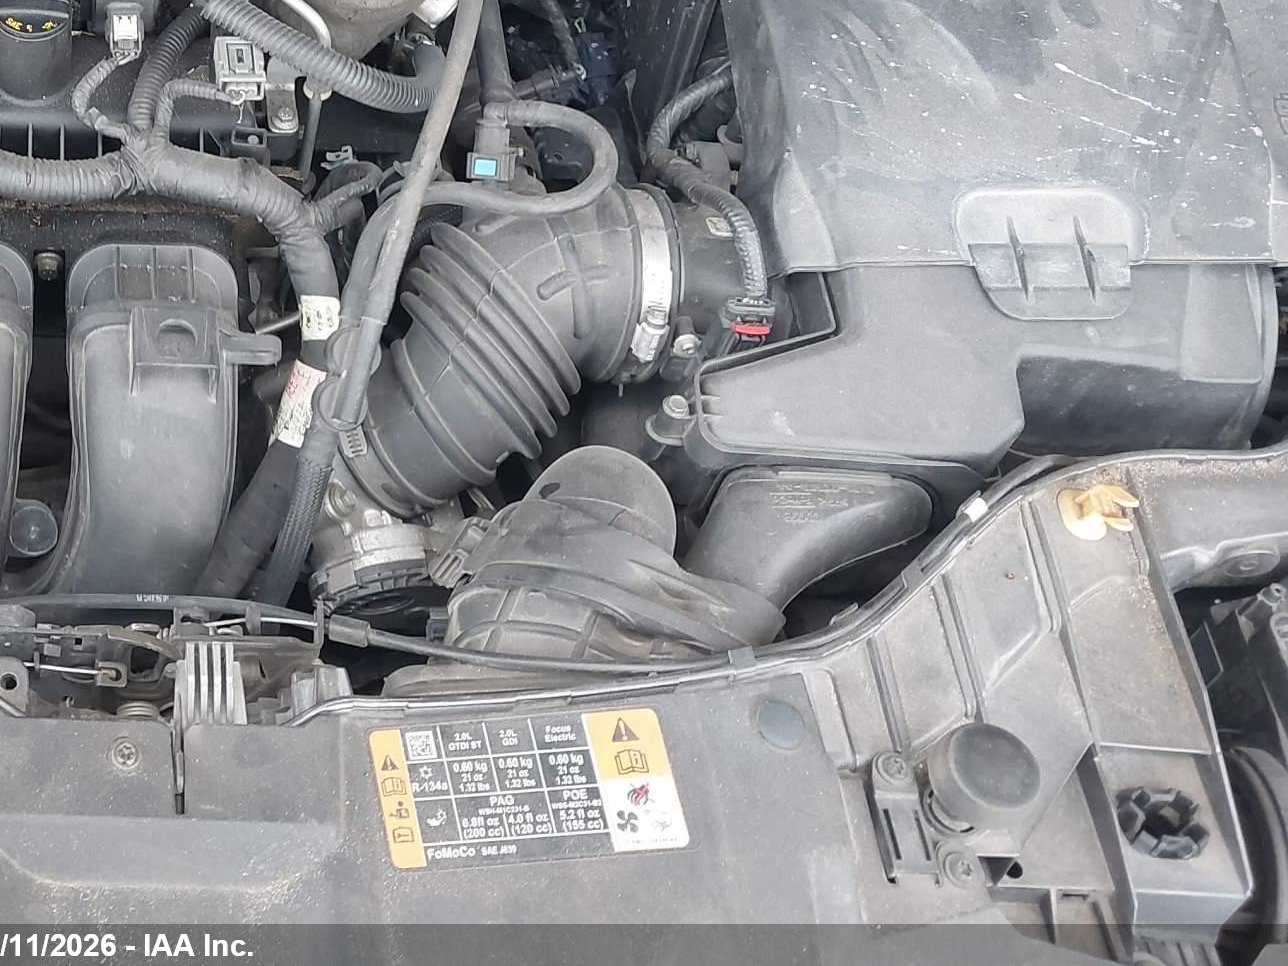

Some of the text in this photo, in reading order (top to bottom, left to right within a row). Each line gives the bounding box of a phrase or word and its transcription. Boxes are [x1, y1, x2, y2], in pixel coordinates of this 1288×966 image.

[6, 18, 23, 30] SAE
[499, 730, 518, 738] 2.0L
[545, 726, 571, 734] Focus
[454, 732, 472, 740] 2.0L
[544, 734, 576, 742] Electric
[448, 740, 482, 750] GTDI ST
[502, 738, 518, 746] GDI
[498, 756, 532, 769] 0.60 kg
[549, 753, 584, 765] 0.60 kg
[452, 761, 488, 772] 0.60 kg
[558, 766, 580, 775] 21 oz
[461, 774, 484, 782] 21 oz
[506, 770, 517, 778] 21
[505, 778, 536, 788] 1.32 lbs
[556, 775, 587, 785] 1.32 lbs
[412, 781, 448, 792] R-134a
[460, 782, 490, 792] 1.32 lbs
[562, 788, 588, 800] POE
[490, 795, 514, 806] PAG
[508, 813, 549, 824] 4.0 fl oz
[560, 809, 600, 820] 5.2 fl oz
[486, 818, 500, 826] oz
[587, 818, 604, 831] cc)
[464, 826, 504, 839] (200 cc)
[512, 822, 552, 836] (120 cc)
[428, 846, 476, 860] FoMoCo
[481, 846, 498, 856] SAE
